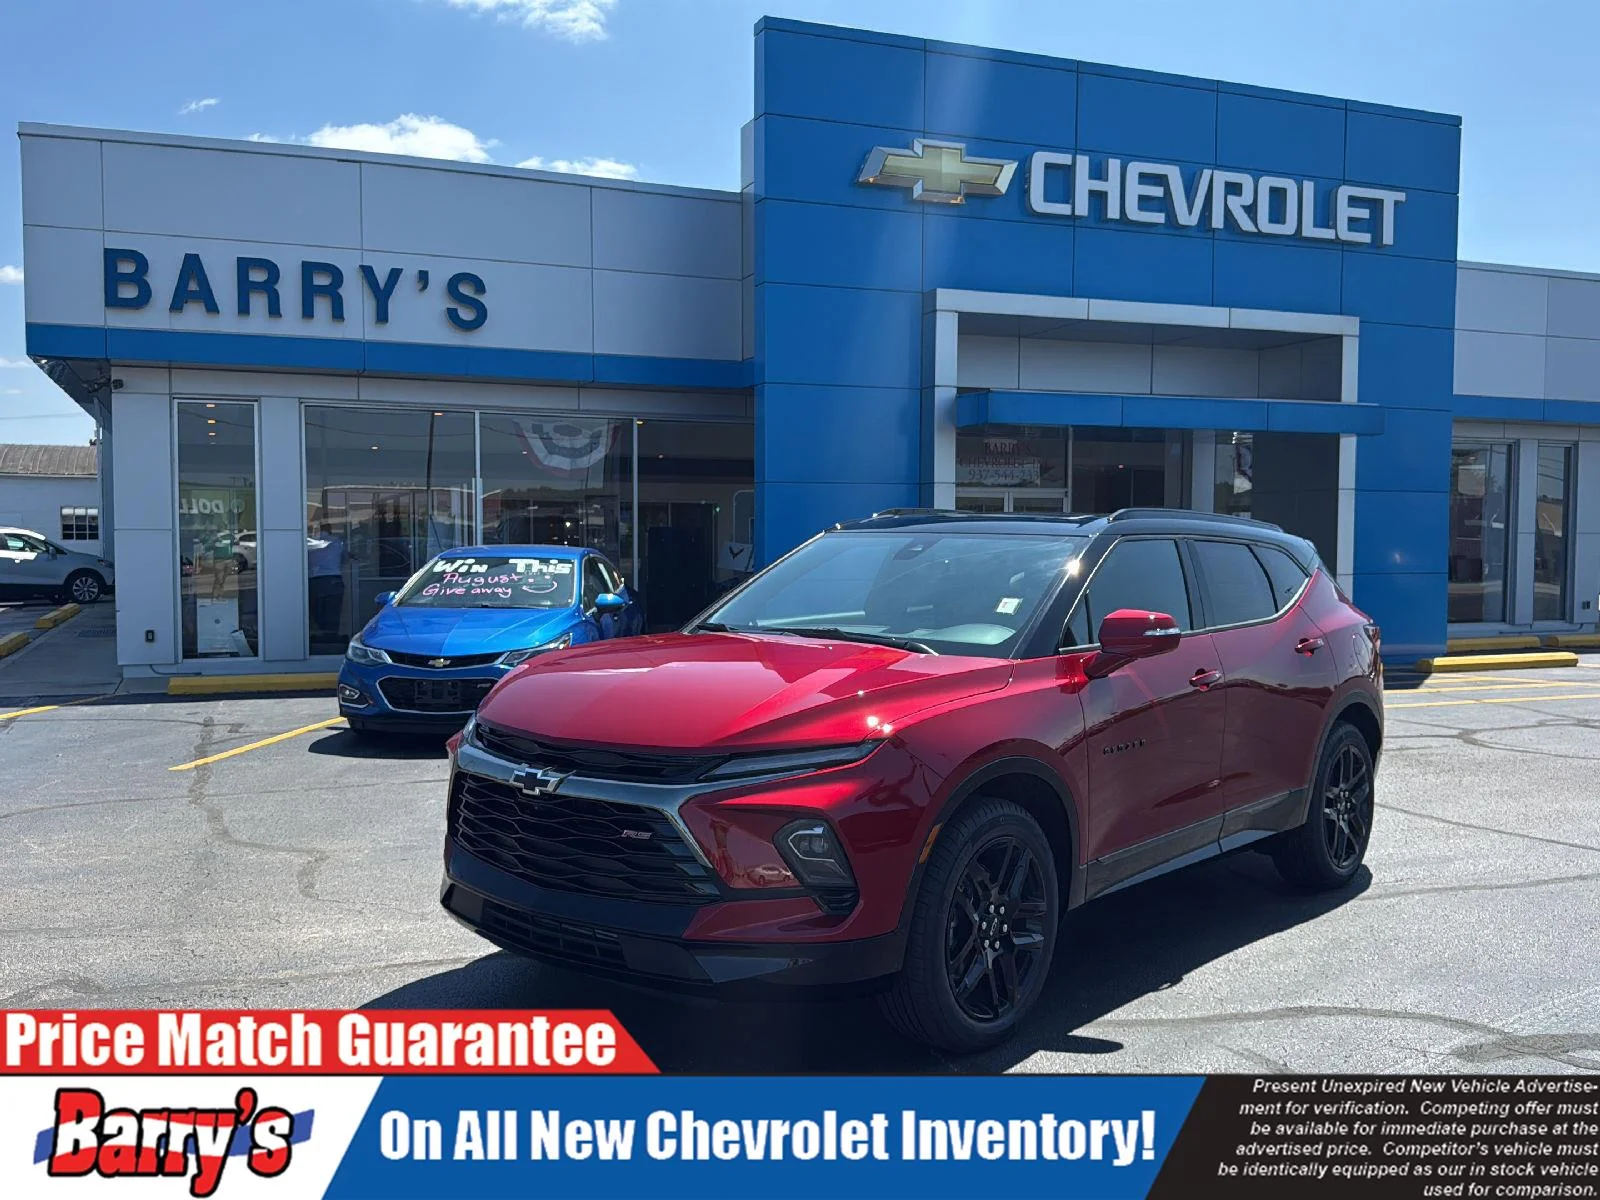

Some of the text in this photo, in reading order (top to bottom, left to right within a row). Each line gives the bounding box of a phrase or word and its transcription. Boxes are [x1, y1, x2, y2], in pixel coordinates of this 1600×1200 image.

[1028, 150, 1407, 247] CHEVROLET
[103, 247, 489, 332] BARRY'S
[432, 558, 573, 574] Win This
[443, 572, 521, 587] August
[422, 583, 513, 598] Give away
[621, 829, 652, 840] RS
